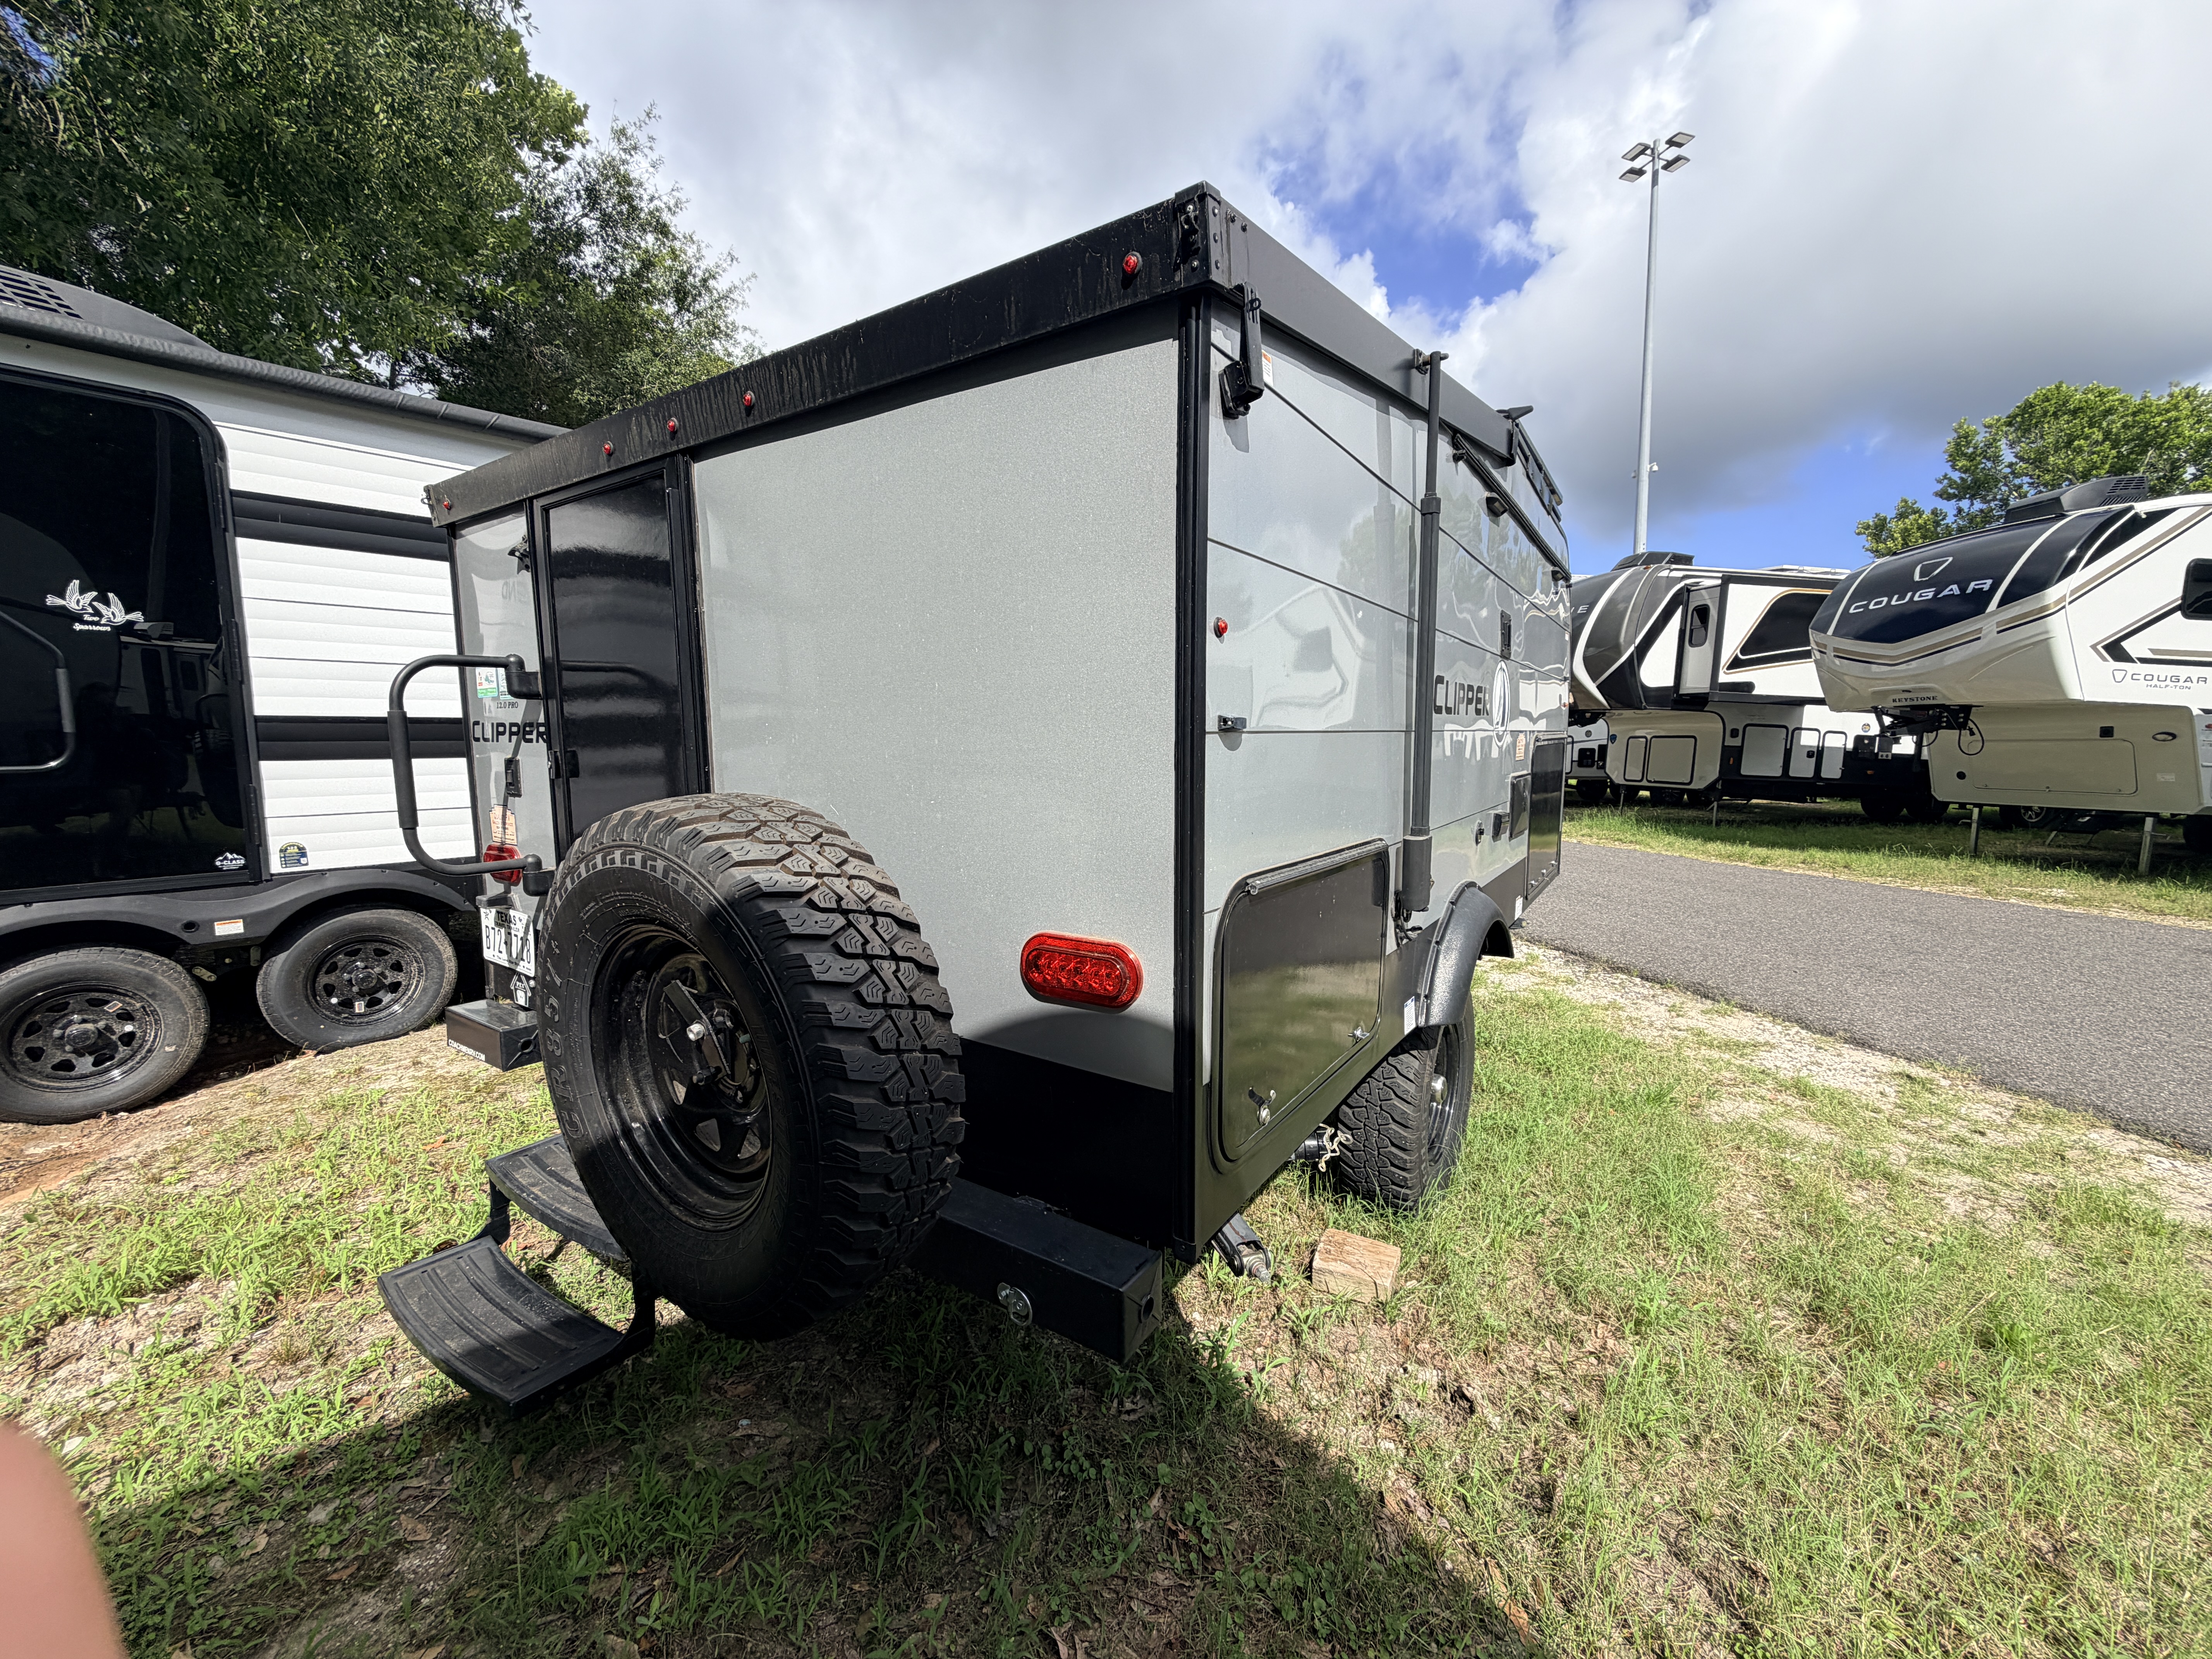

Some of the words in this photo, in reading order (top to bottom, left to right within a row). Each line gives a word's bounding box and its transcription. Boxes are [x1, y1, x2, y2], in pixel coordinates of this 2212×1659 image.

[1848, 579, 1993, 613] COUGAR
[73, 623, 111, 632] Sparrows
[2131, 673, 2208, 684] COUGAR
[1433, 675, 1490, 716] CLIPPER
[472, 720, 548, 744] CLIPPER
[496, 910, 517, 926] TEXAS
